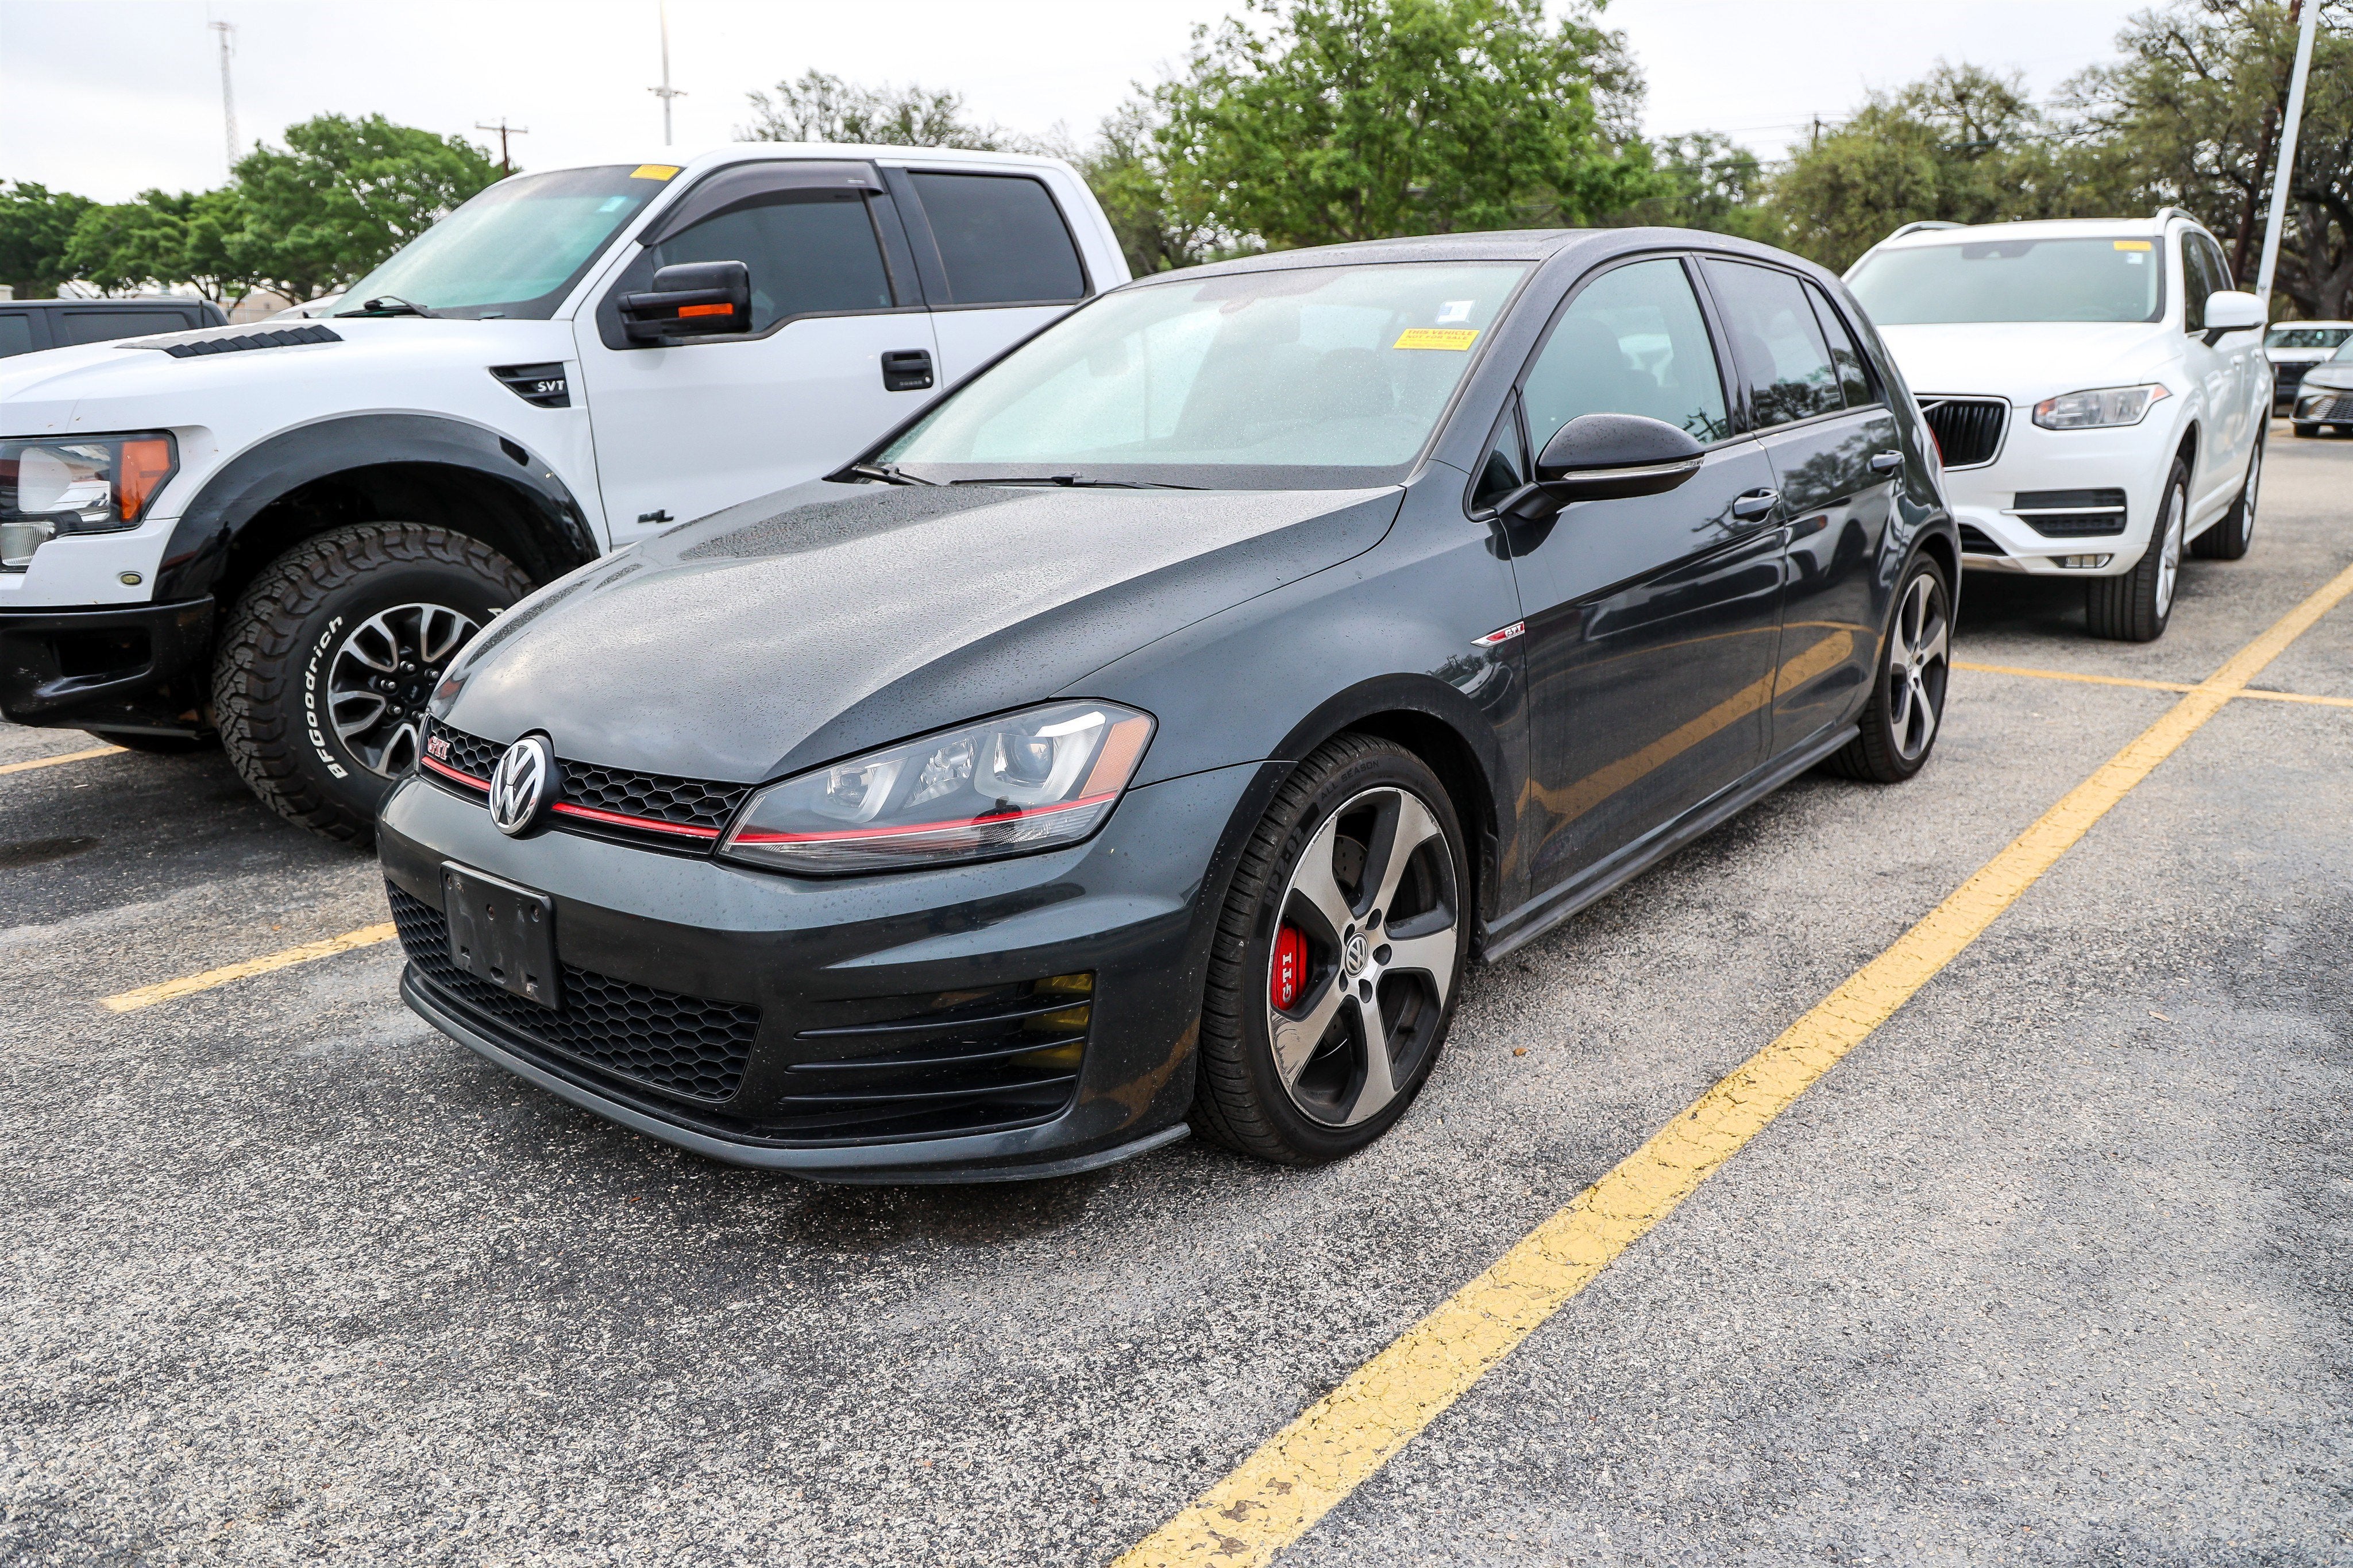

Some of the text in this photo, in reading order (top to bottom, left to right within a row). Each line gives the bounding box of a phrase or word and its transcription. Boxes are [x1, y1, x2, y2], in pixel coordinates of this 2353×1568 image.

[538, 380, 564, 392] SVT
[1505, 624, 1521, 638] GTI
[304, 616, 349, 779] BFGoodrich
[428, 736, 450, 760] GTI
[1321, 783, 1339, 802] ALL
[1341, 759, 1379, 783] SEASON
[1263, 826, 1304, 907] HPZ-02
[1283, 952, 1292, 1003] GTI
